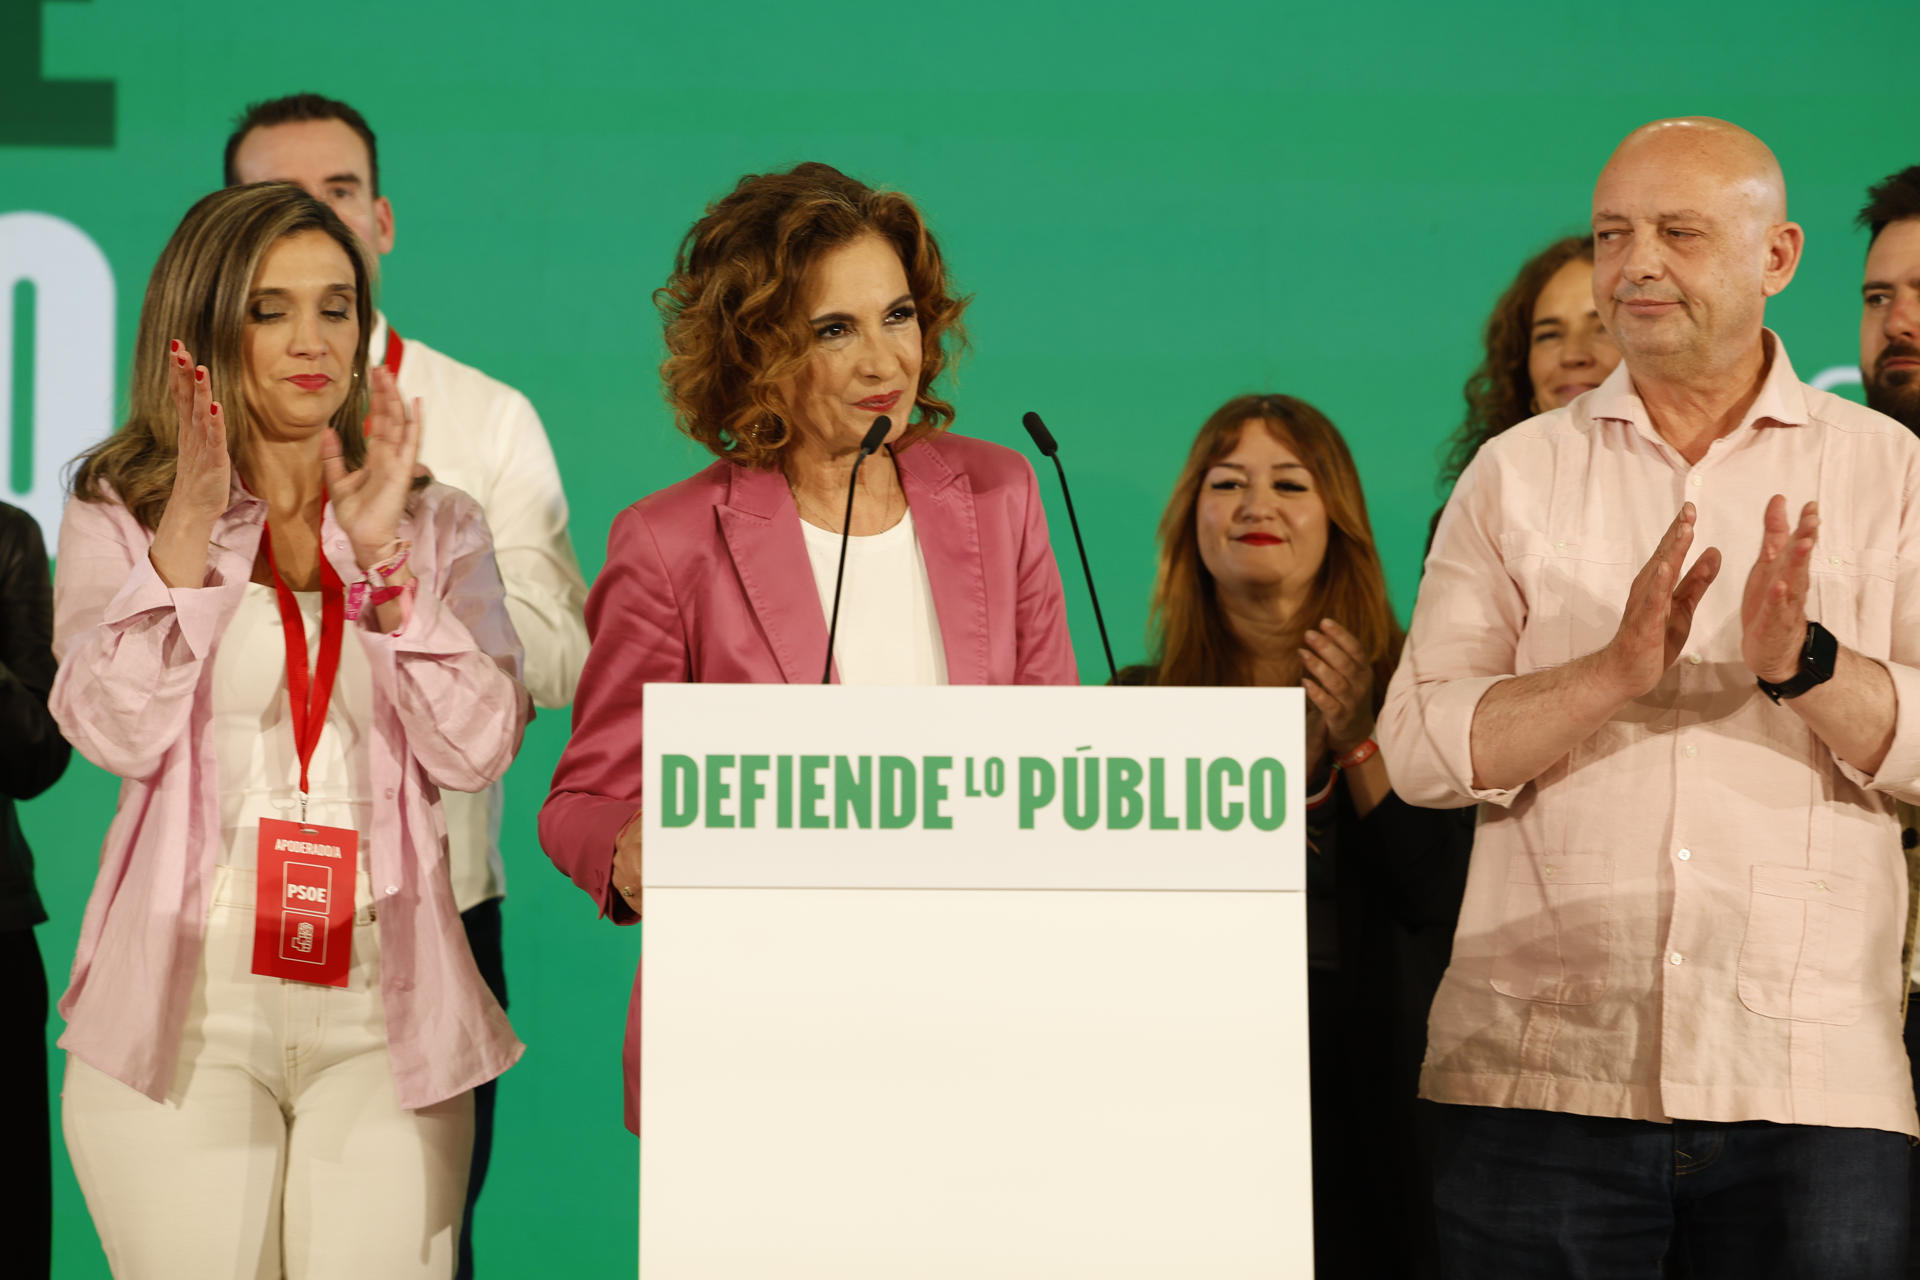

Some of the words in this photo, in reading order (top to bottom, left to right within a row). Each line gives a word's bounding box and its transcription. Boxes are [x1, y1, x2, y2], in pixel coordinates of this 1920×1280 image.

[661, 754, 952, 828] DEFIENDE
[966, 757, 1004, 796] LO
[1019, 746, 1286, 830] PÚBLICO
[287, 883, 328, 903] PSOE
